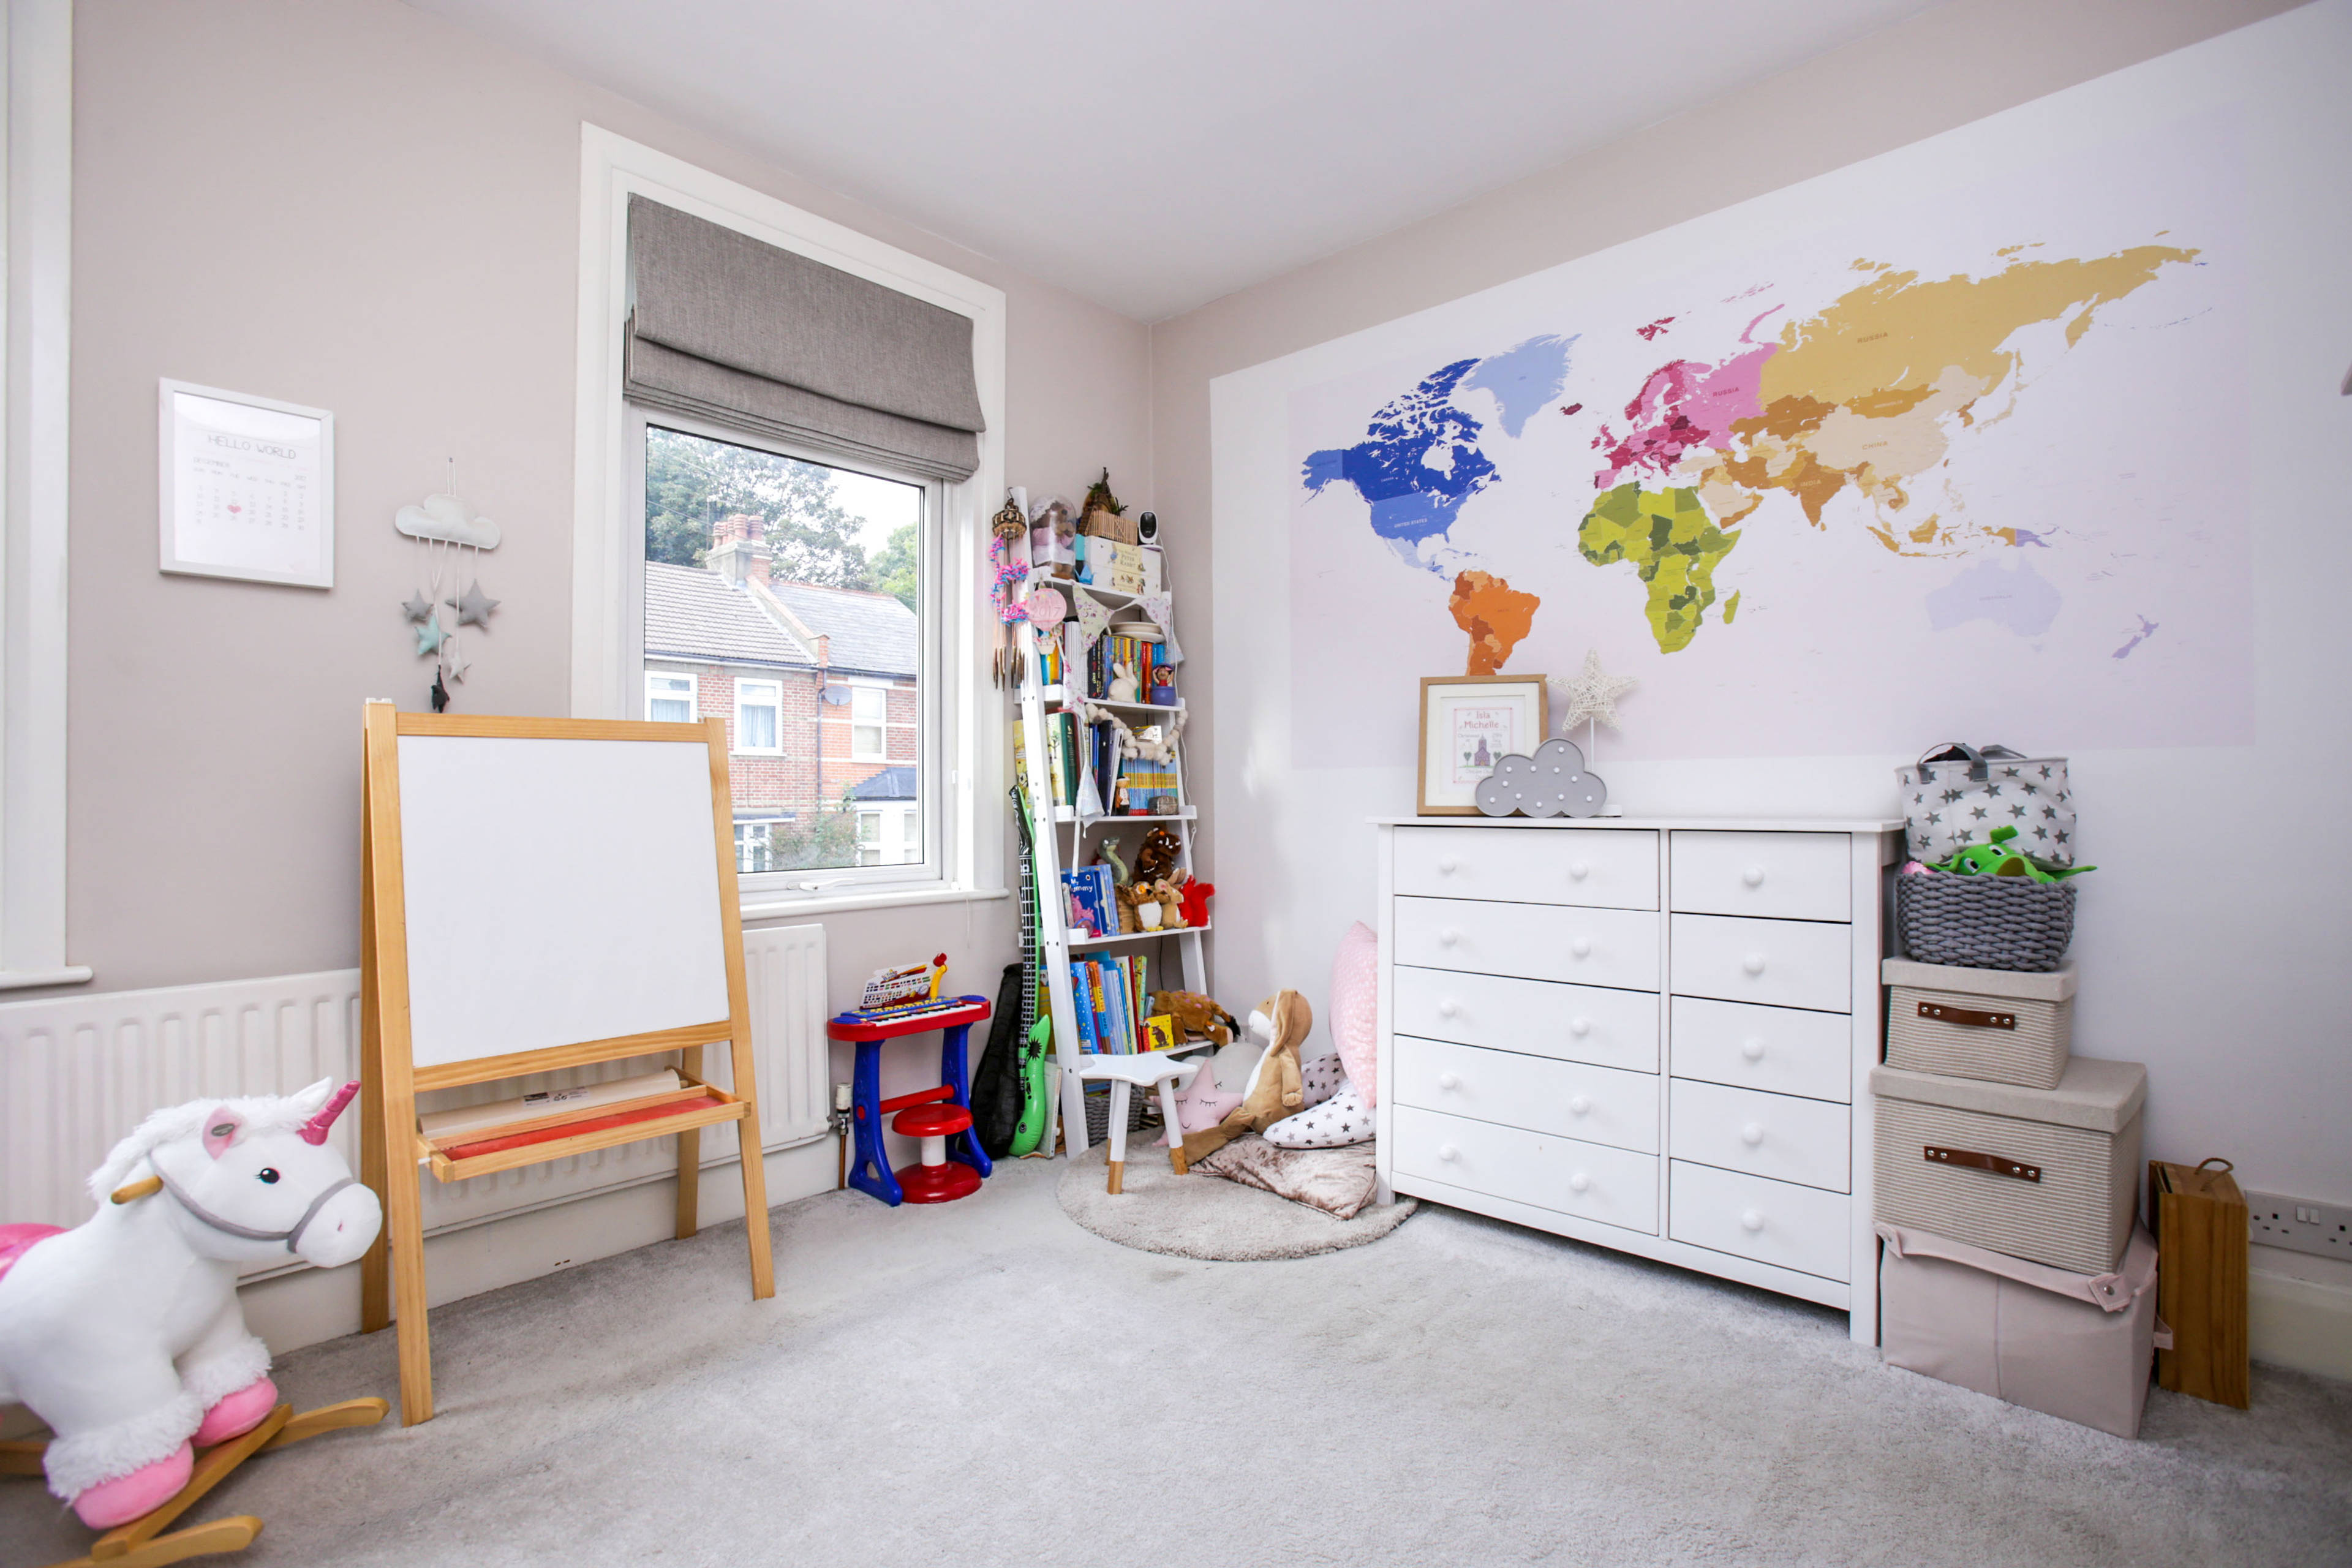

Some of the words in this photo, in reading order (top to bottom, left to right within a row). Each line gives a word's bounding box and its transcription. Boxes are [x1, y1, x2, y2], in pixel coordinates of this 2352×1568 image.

[1857, 331, 1888, 344] RUSSIA
[1713, 386, 1740, 398] RUSSIA
[208, 434, 251, 451] HELLO
[256, 443, 296, 459] WORLD
[1862, 440, 1888, 450] CHINA
[1800, 478, 1822, 487] INDIA
[1476, 710, 1491, 720] Isla
[1464, 720, 1500, 729] Michelle
